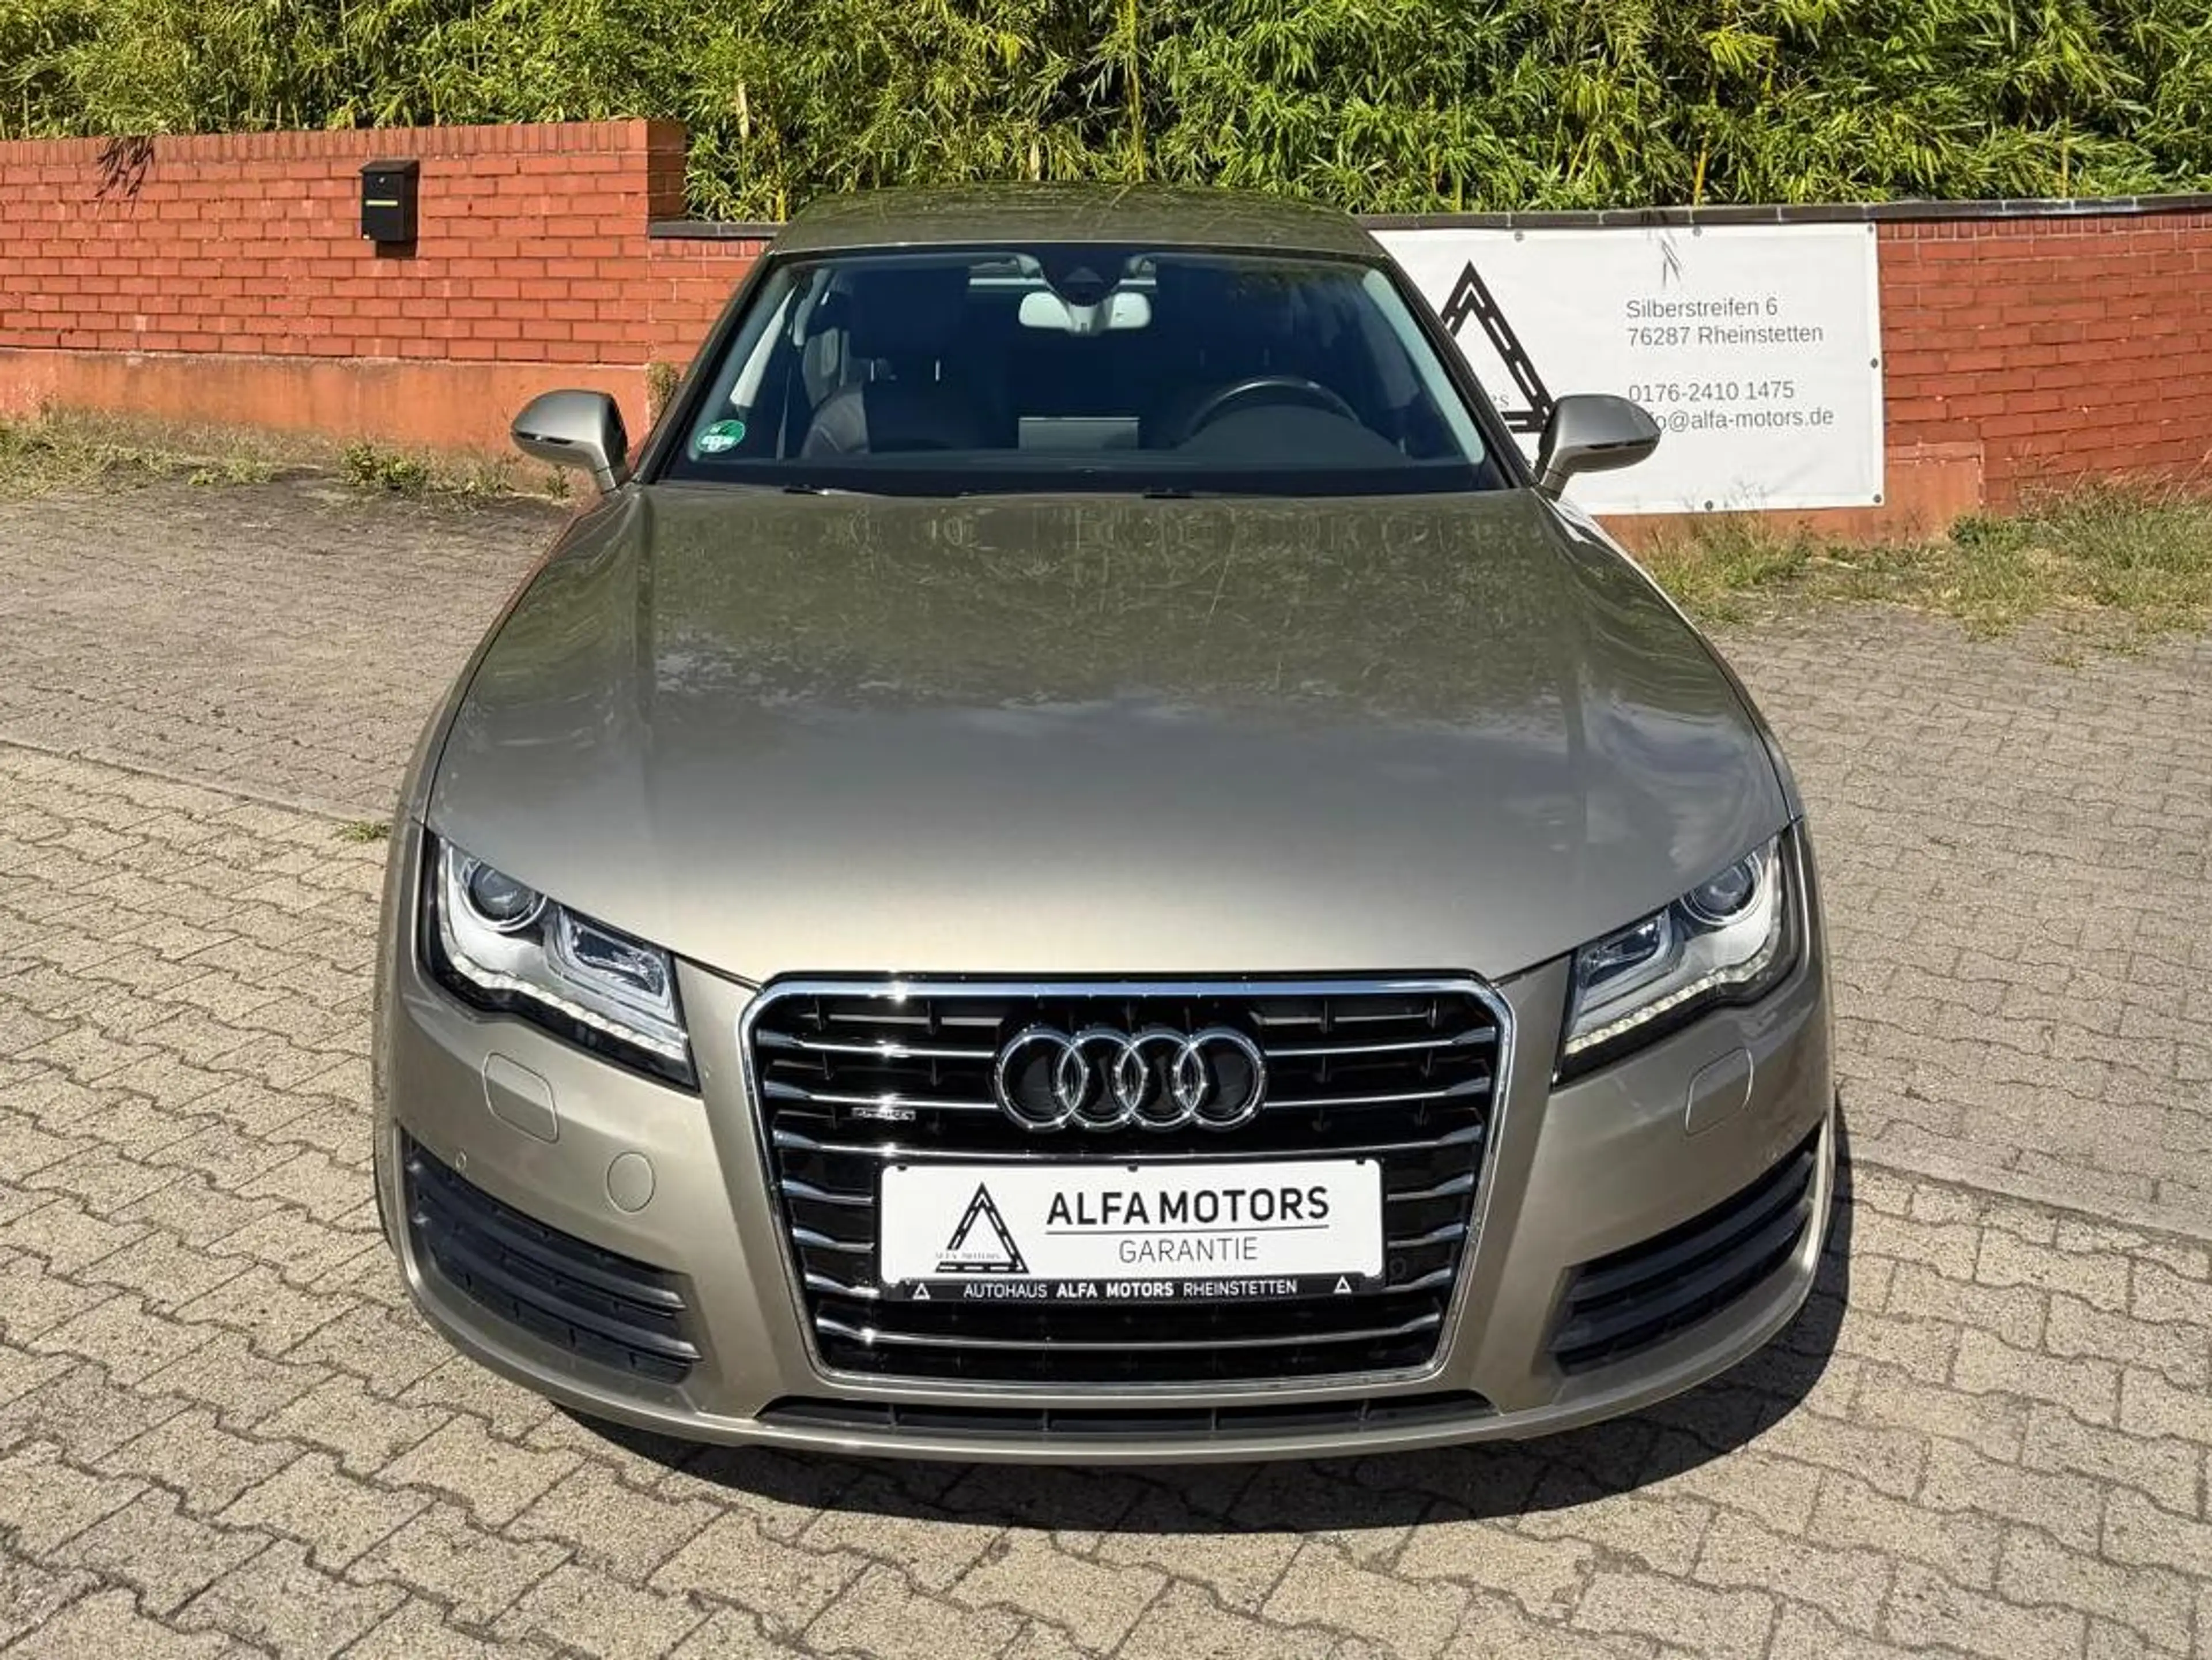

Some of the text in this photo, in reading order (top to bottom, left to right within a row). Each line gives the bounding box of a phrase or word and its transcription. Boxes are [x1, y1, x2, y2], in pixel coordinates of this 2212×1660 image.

[1626, 296, 1778, 318] Silberstreifen 6
[1627, 325, 1824, 346] 76287 Rheinstetten
[1629, 380, 1794, 402] 0176-2410 1475
[1650, 407, 1834, 432] o@alfa-motors.de
[1047, 1186, 1330, 1225] ALFA MOTORS
[1119, 1236, 1258, 1263] GARANTIE
[964, 1278, 1297, 1298] AUTOHAUS ALFA MOTORS RHEINSTETTEN
